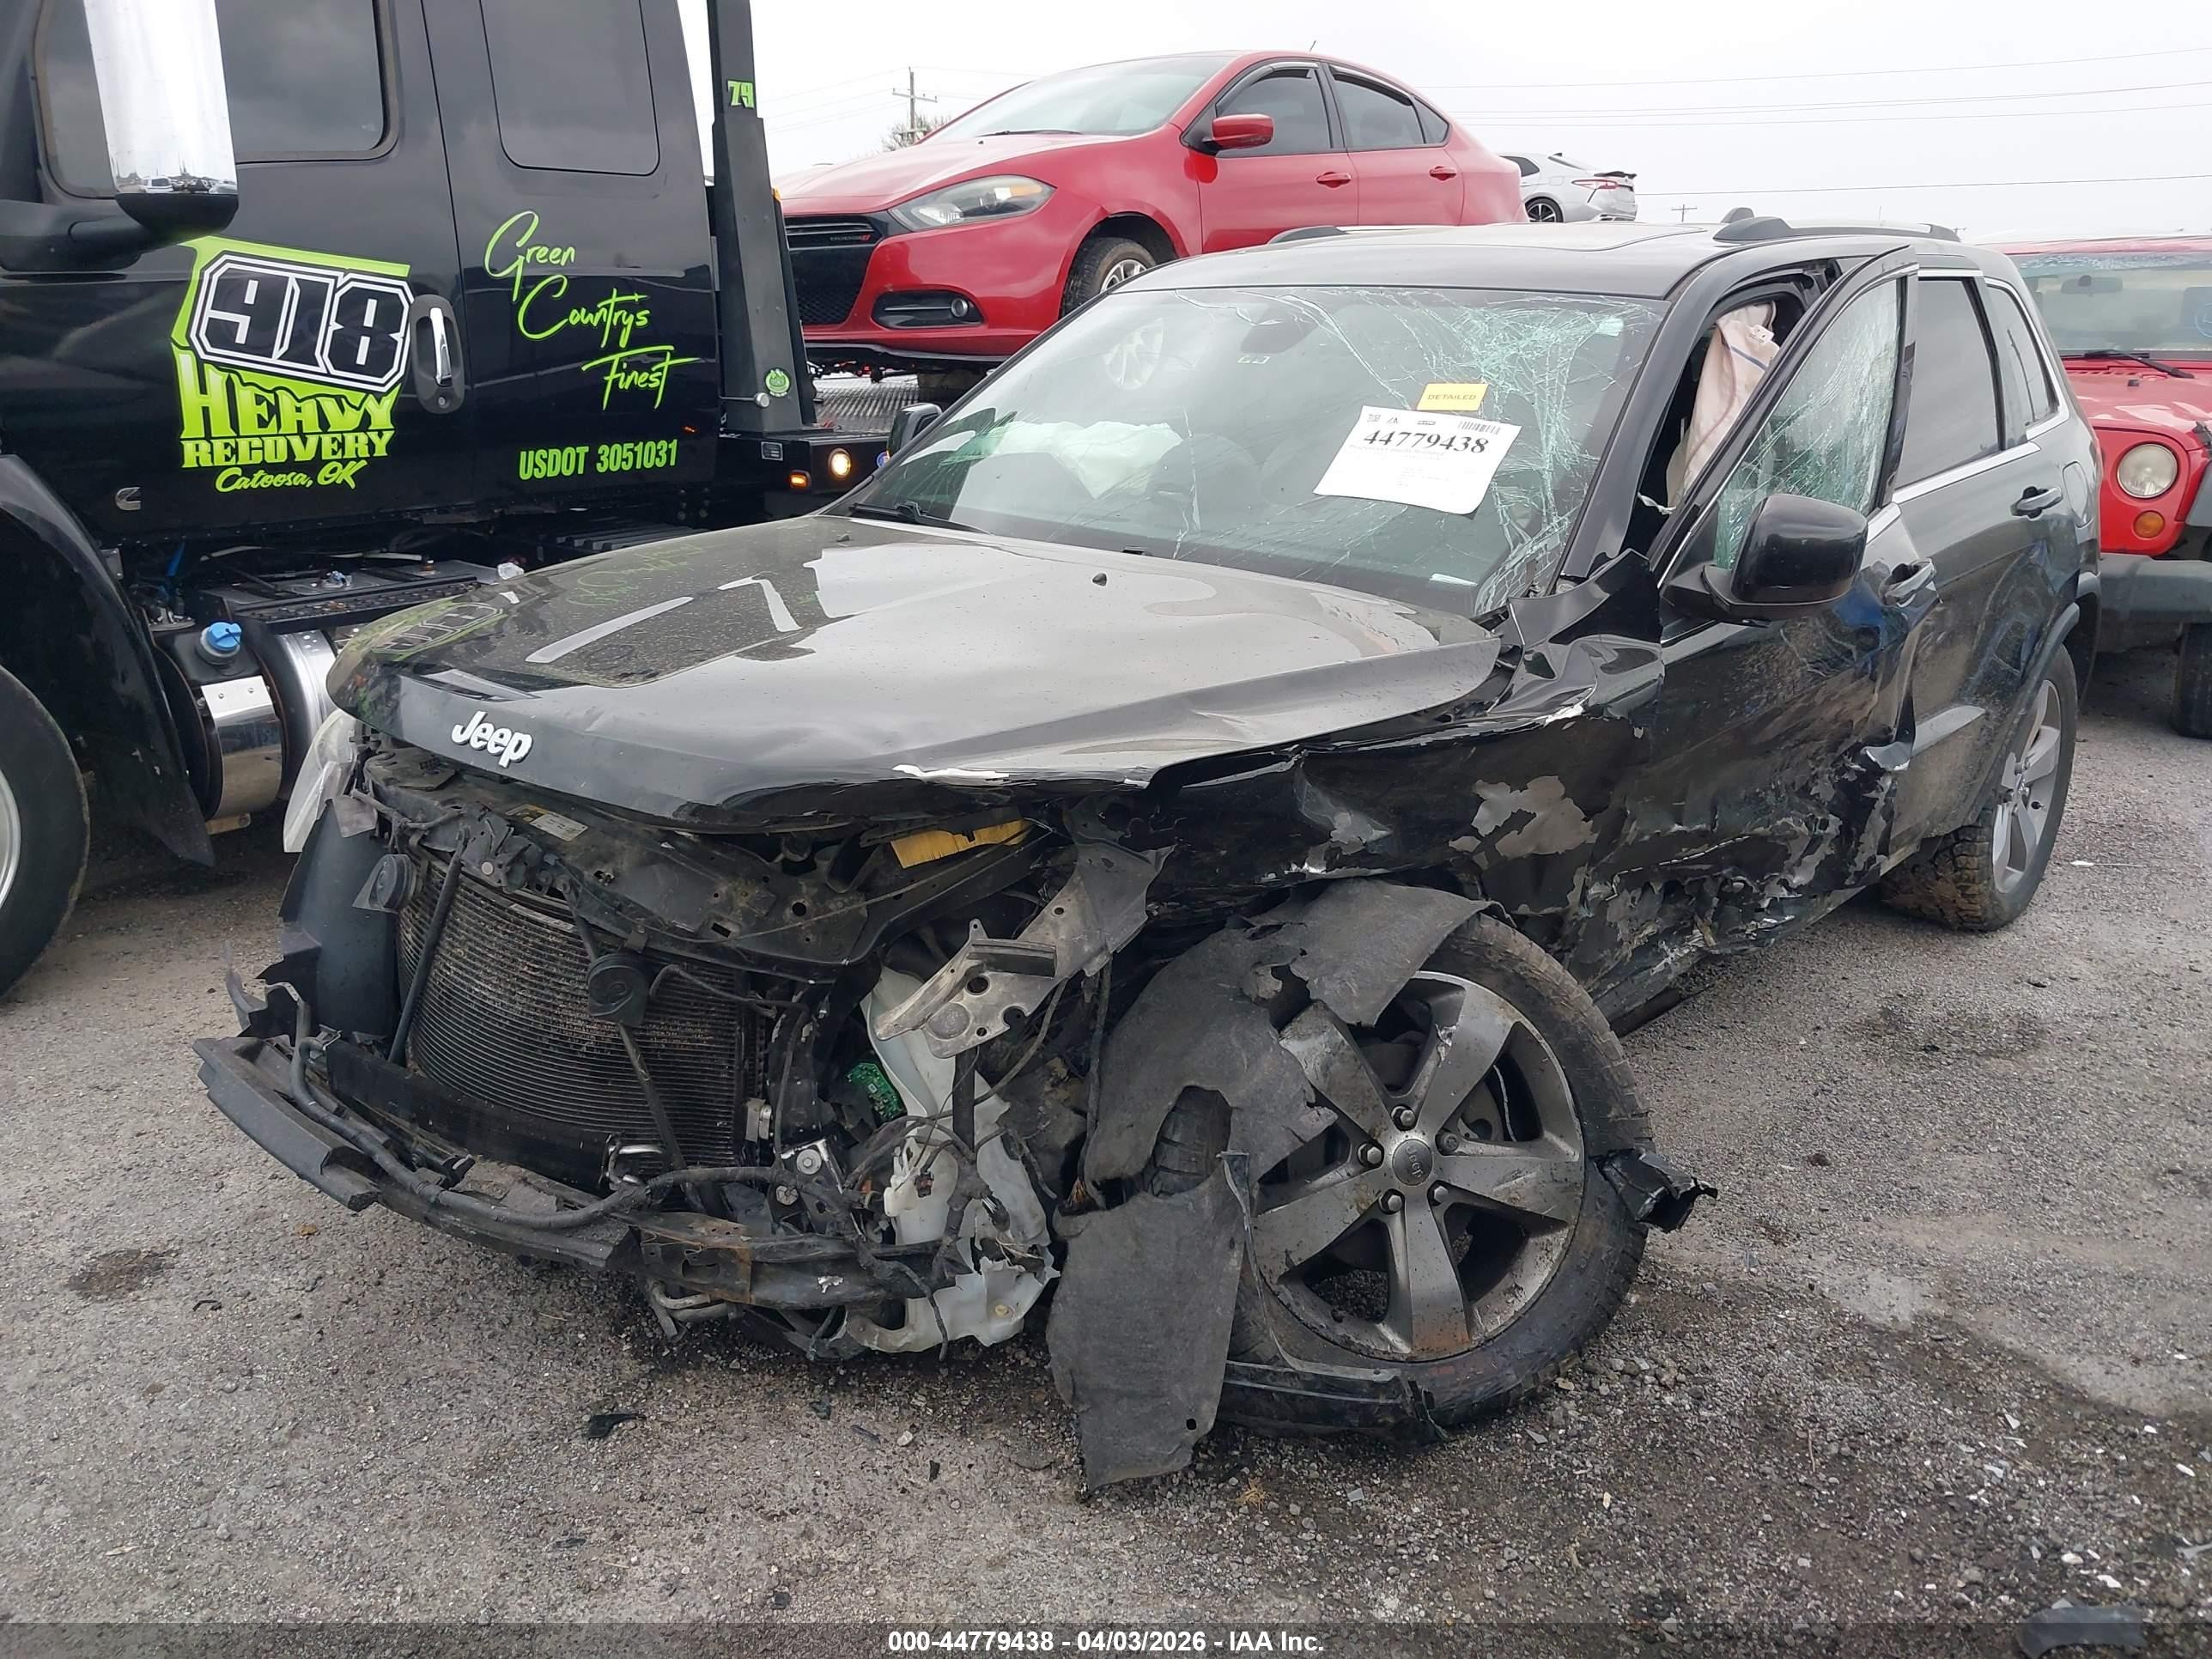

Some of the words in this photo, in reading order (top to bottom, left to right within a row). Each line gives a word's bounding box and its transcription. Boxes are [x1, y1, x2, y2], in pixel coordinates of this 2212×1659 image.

[727, 80, 755, 108] 79
[484, 210, 576, 302] Green
[190, 254, 415, 393] 918
[173, 346, 402, 439] HEAVY
[580, 345, 702, 410] Finest
[179, 429, 395, 468] RECOVERY
[519, 445, 589, 481] USDOT
[596, 439, 678, 473] 3051031
[1363, 428, 1490, 454] 44779438
[215, 466, 313, 493] Catoosa,
[317, 459, 368, 489] OK
[451, 709, 533, 769] Jeep
